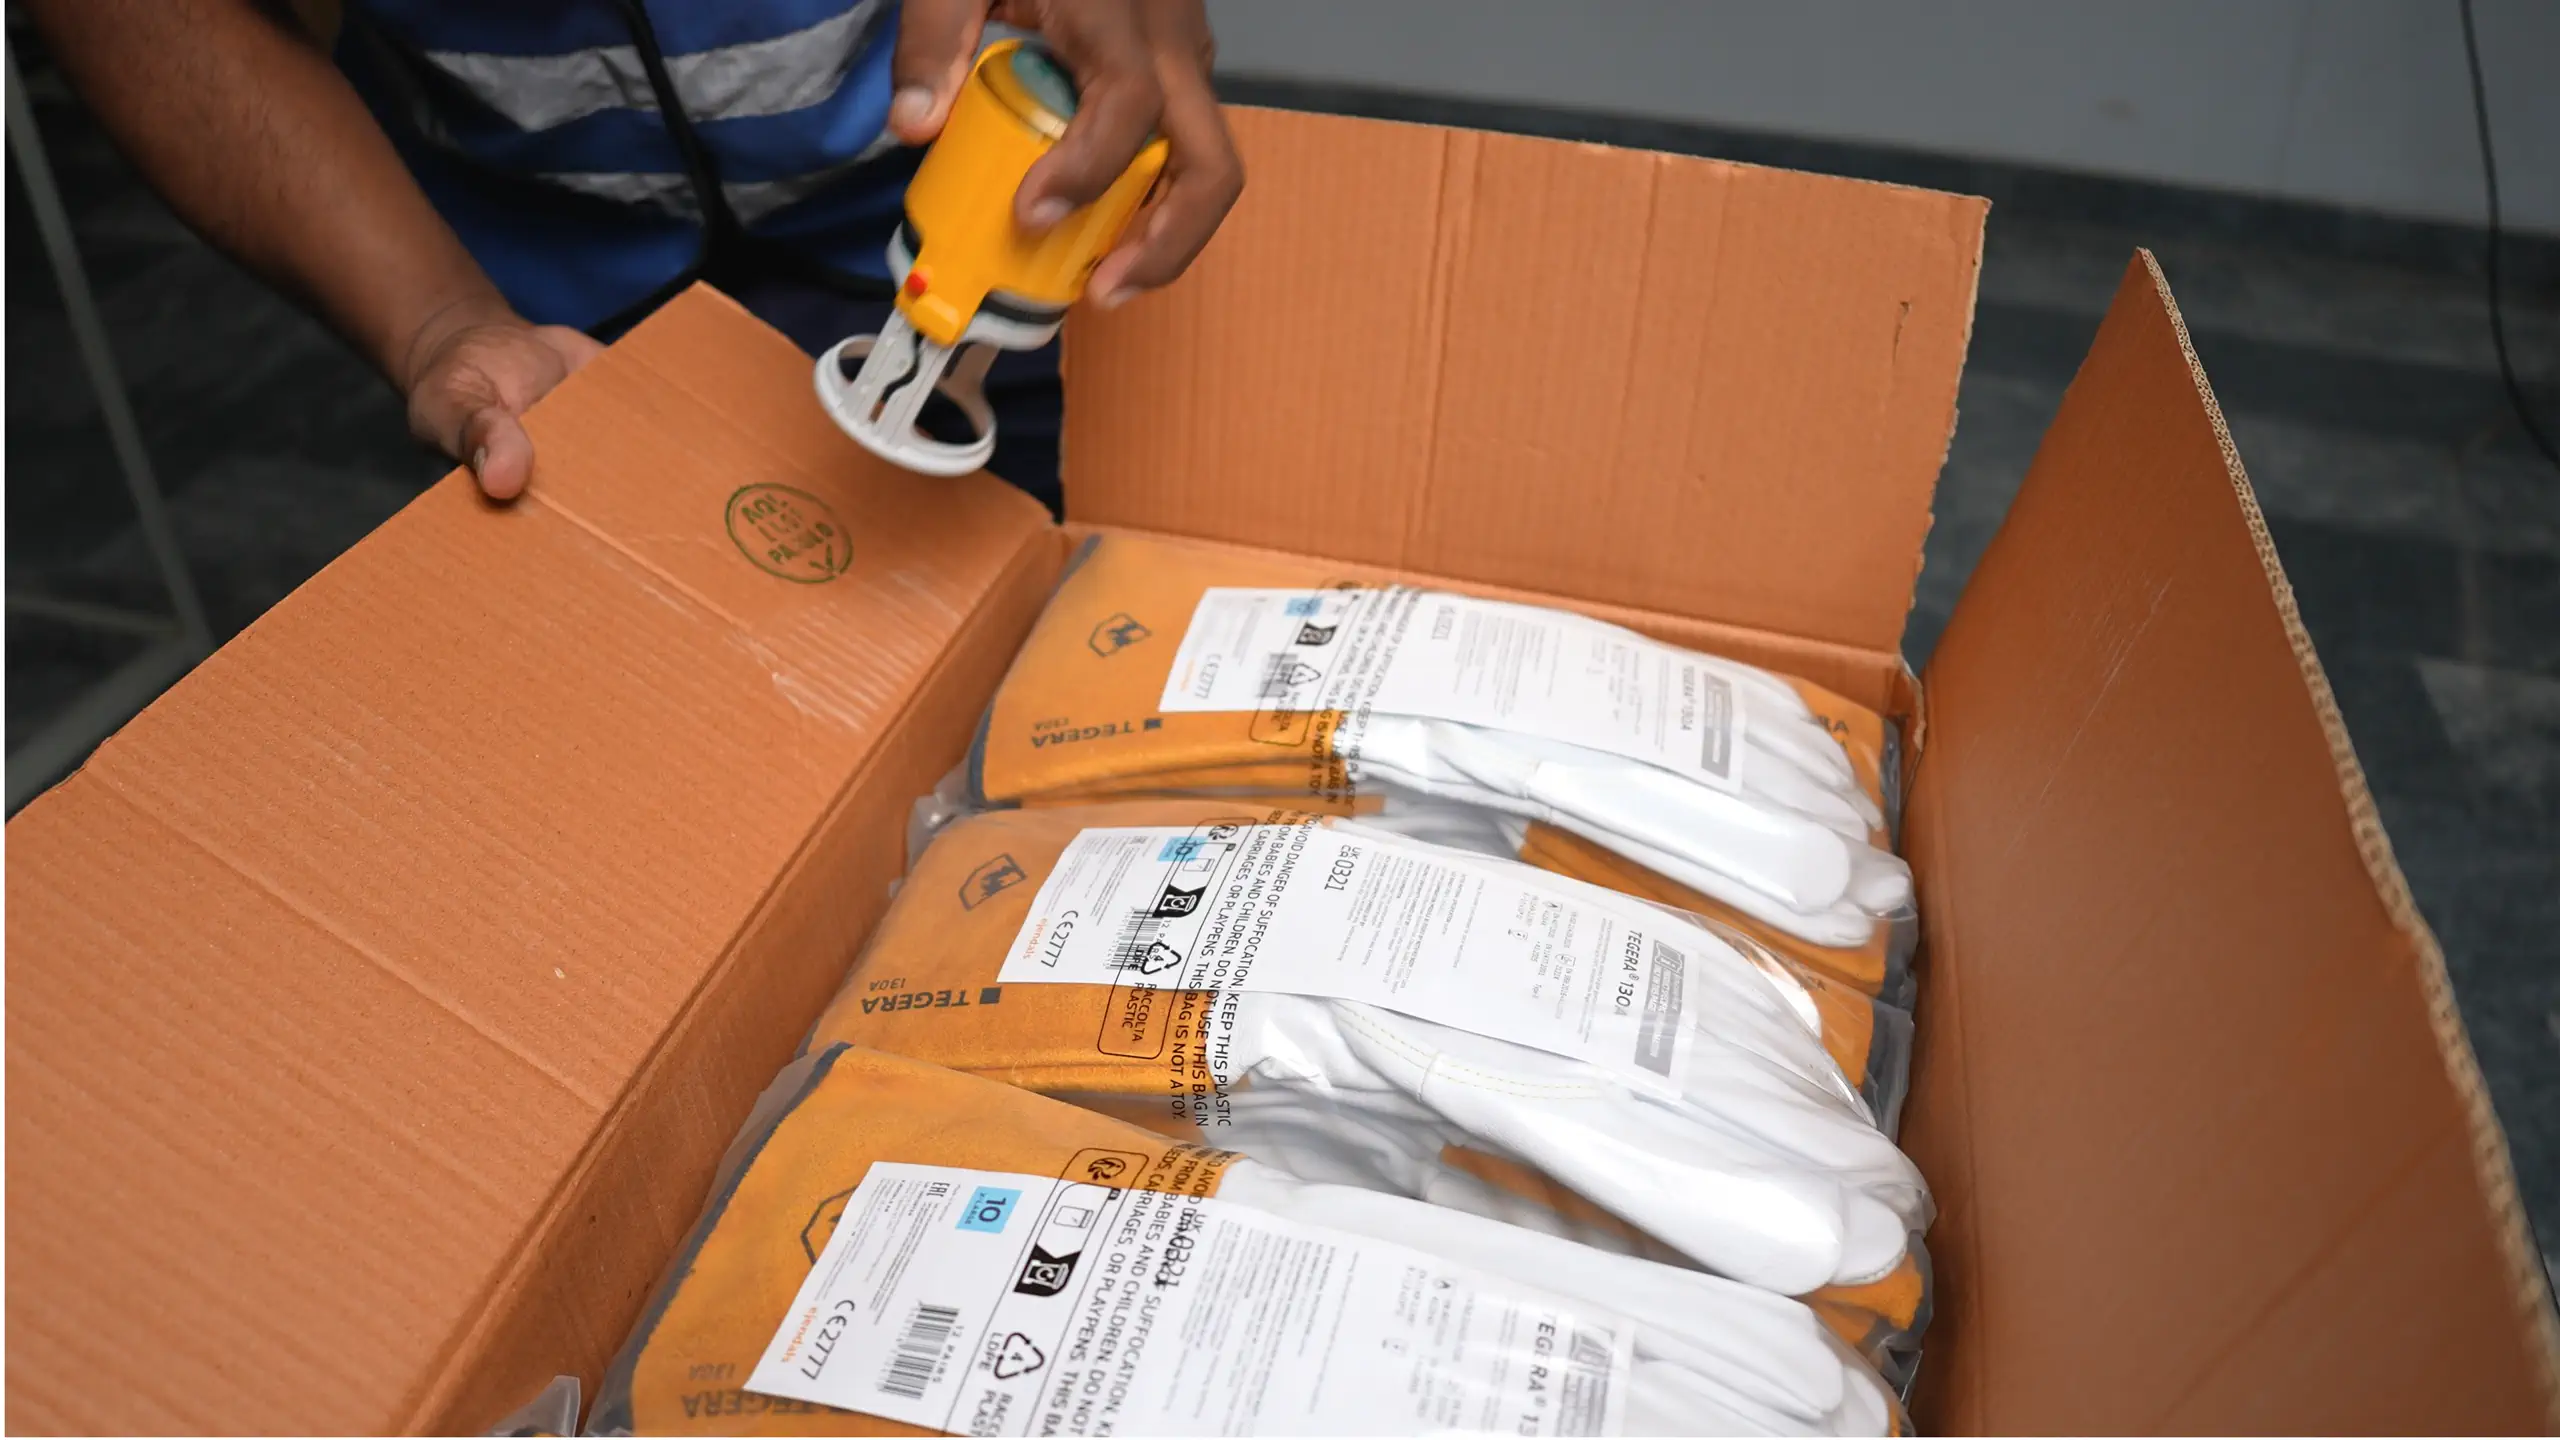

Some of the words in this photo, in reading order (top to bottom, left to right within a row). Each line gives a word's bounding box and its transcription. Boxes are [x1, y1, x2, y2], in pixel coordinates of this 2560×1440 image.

[1031, 720, 1135, 748] TEGERA
[1290, 823, 1313, 851] AVOID
[1233, 829, 1270, 882] CARRIAGES,
[1258, 842, 1284, 877] BABIES
[1247, 877, 1266, 900] AND
[1271, 853, 1300, 893] DANGER
[1324, 859, 1355, 891] 0321
[1226, 884, 1243, 900] OR
[1265, 894, 1281, 908] OF
[1228, 910, 1272, 988] SUFFOCATION,
[1189, 961, 1210, 990] THIS
[1214, 960, 1231, 978] DO
[869, 978, 907, 992] 130A
[1204, 979, 1223, 1008] NOT
[1615, 981, 1635, 1016] 130A
[861, 990, 970, 1014] TEGERA
[1122, 982, 1145, 1028] PLASTIC
[1132, 983, 1157, 1042] RACCOLTA
[1178, 991, 1198, 1021] BAG
[1220, 992, 1240, 1032] KEEP
[1175, 1025, 1191, 1039] IS
[1195, 1010, 1214, 1039] USE
[1171, 1043, 1186, 1076] NOT
[1192, 1043, 1207, 1080] THIS
[1214, 1035, 1231, 1070] THIS
[1170, 1079, 1184, 1089] A
[1193, 1084, 1208, 1112] BAG
[1170, 1092, 1187, 1120] TOY.
[1214, 1074, 1232, 1127] PLASTIC
[1195, 1114, 1209, 1127] IN
[1168, 1159, 1199, 1191] FROM
[1188, 1168, 1217, 1204] AVOID
[979, 1197, 1007, 1222] 10
[1114, 1173, 1165, 1248] CARRIAGES,
[1145, 1192, 1179, 1241] BABIES
[1103, 1252, 1126, 1275] OR
[1131, 1244, 1155, 1277] AND
[1051, 1371, 1081, 1409] THIS
[1084, 1369, 1107, 1396] DO
[1068, 1399, 1094, 1436] NOT
